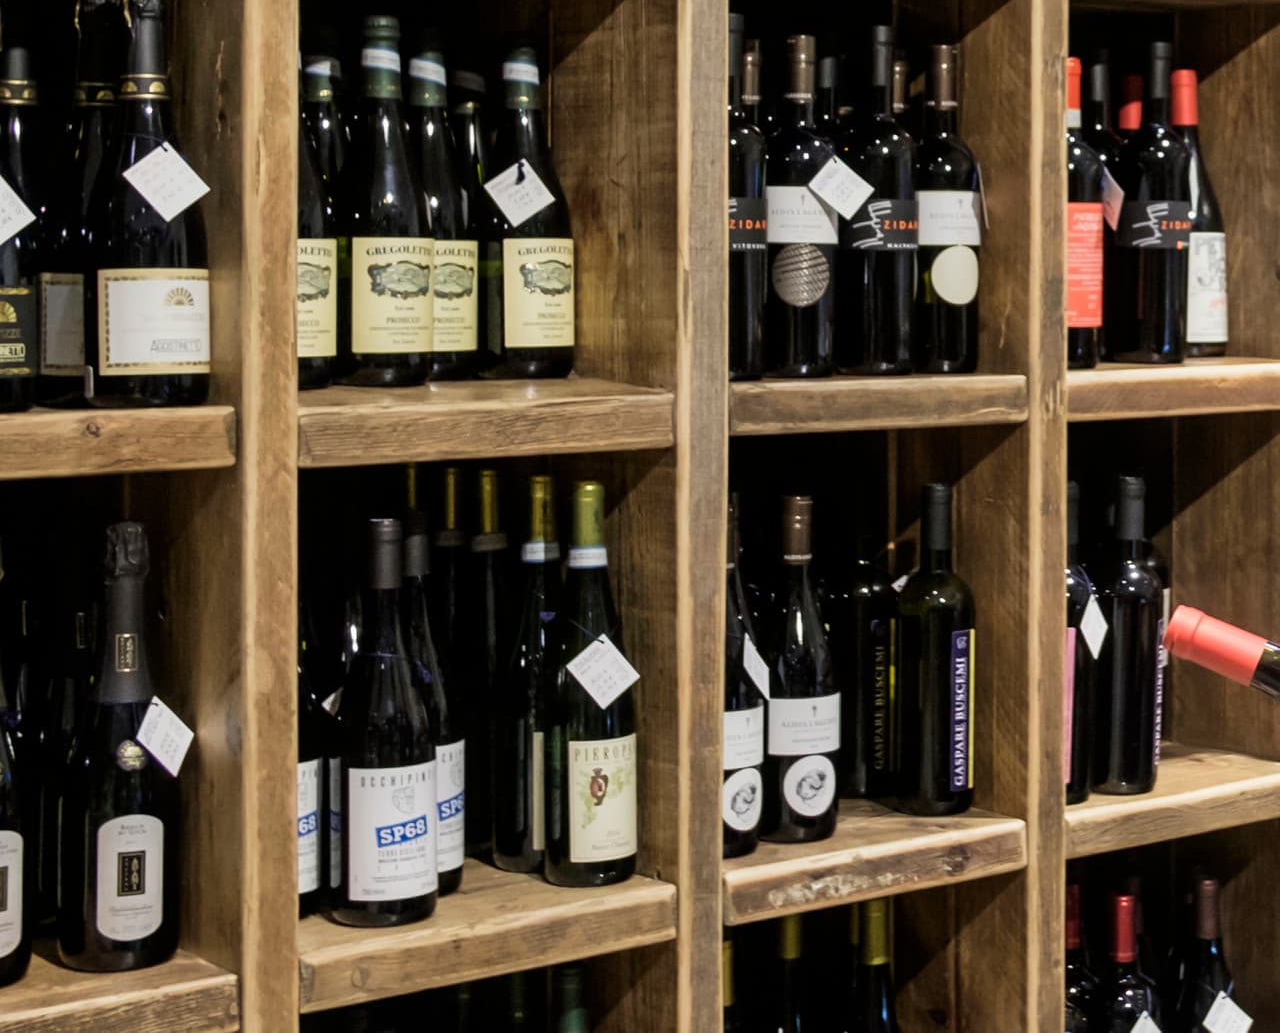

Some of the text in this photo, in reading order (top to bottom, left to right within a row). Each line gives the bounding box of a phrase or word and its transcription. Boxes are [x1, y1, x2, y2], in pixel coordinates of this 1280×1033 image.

[953, 656, 968, 787] GASPARE BUSCEMI
[360, 769, 432, 789] OCCHIPIN
[299, 815, 318, 834] 68
[379, 819, 426, 845] SP68
